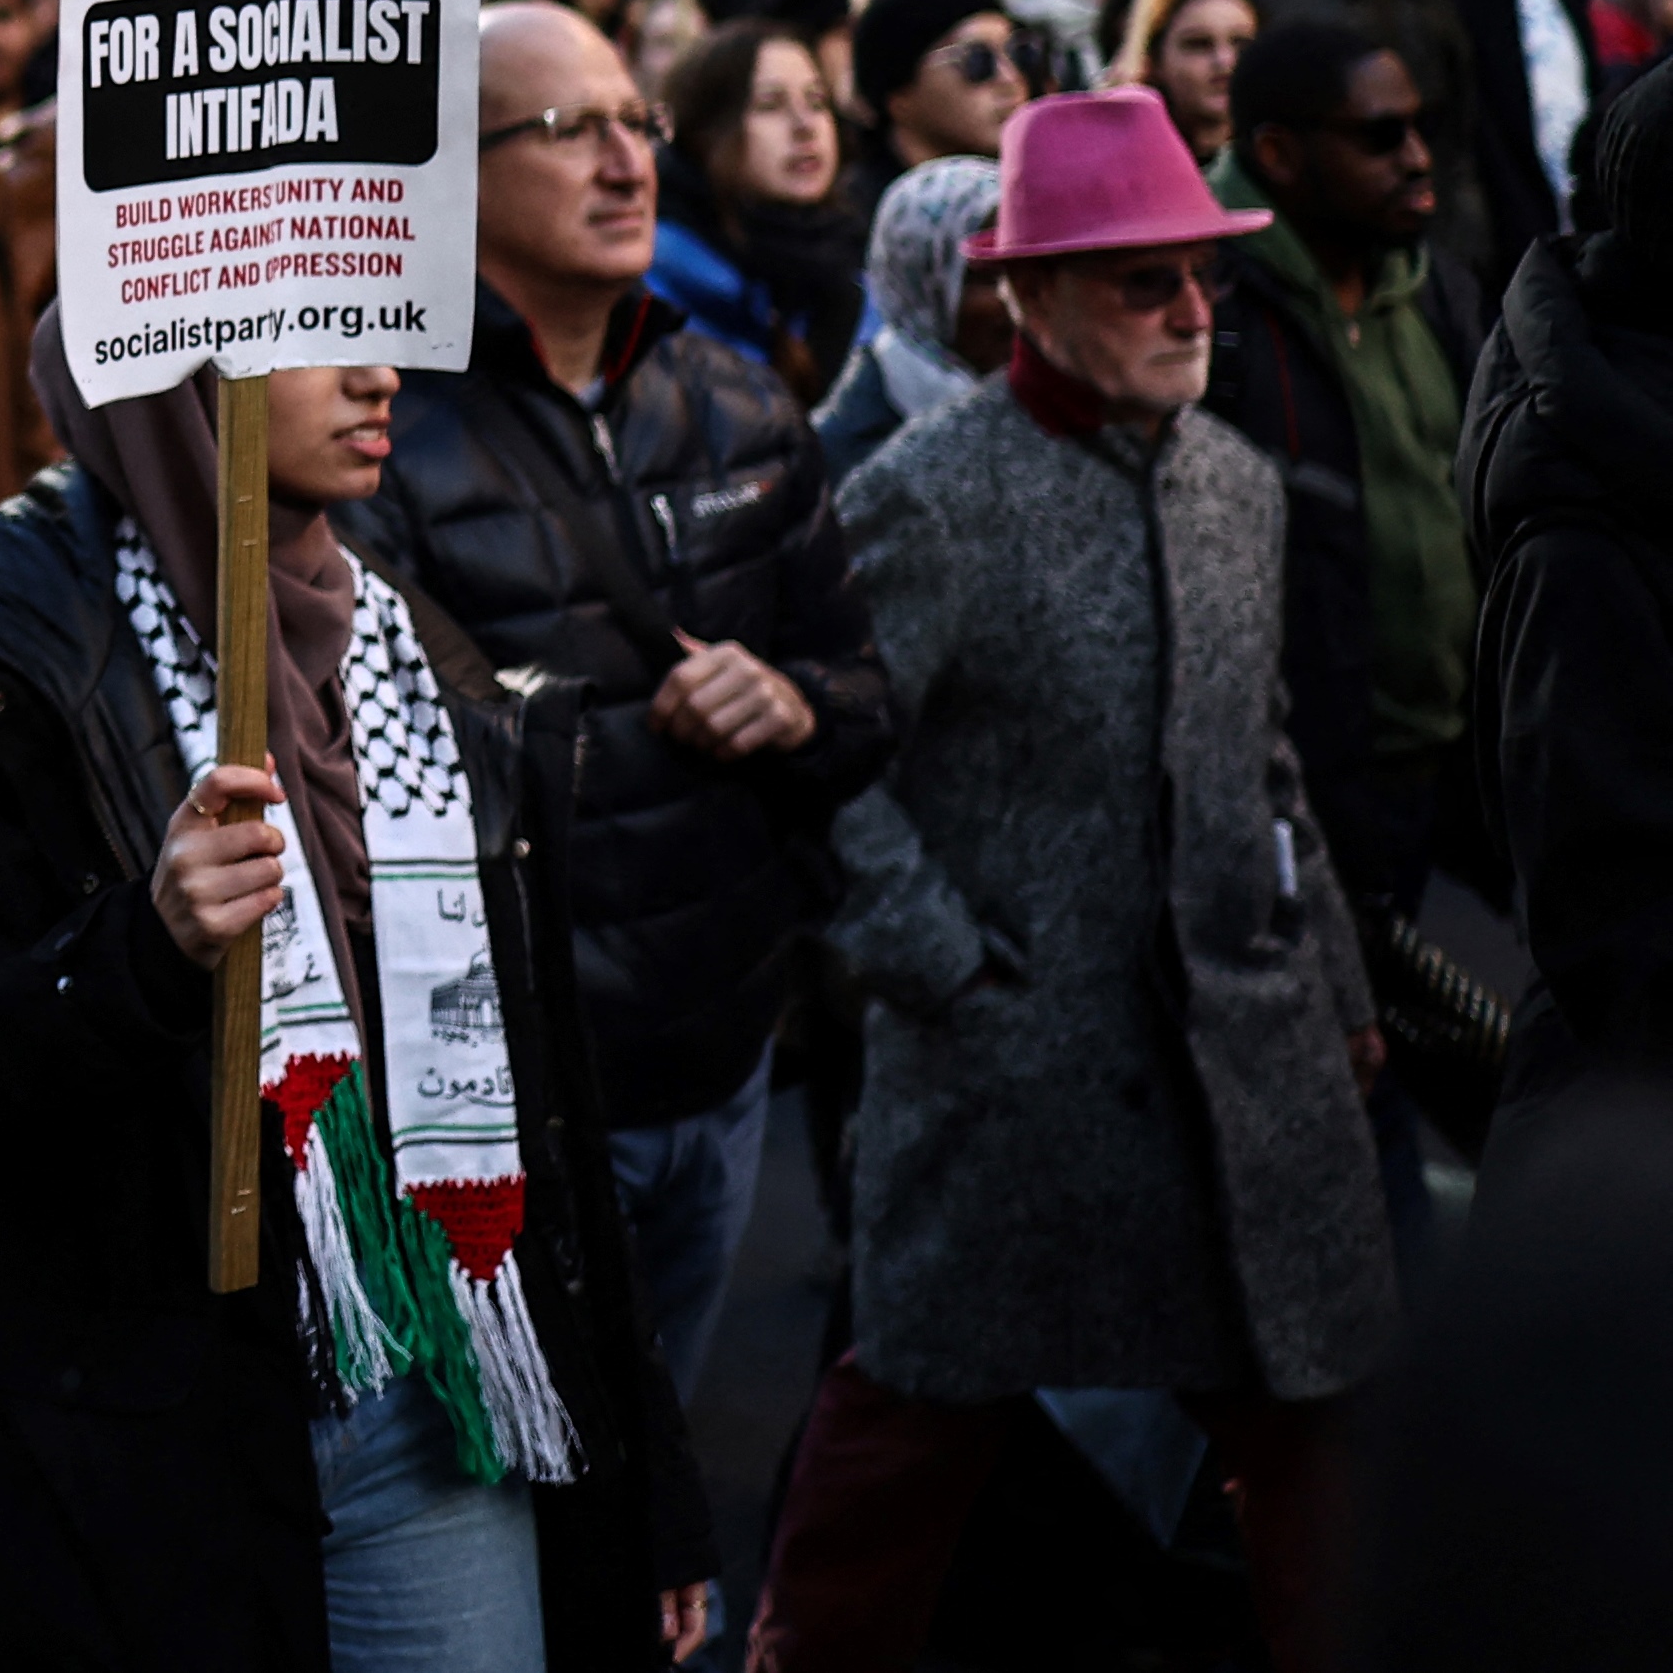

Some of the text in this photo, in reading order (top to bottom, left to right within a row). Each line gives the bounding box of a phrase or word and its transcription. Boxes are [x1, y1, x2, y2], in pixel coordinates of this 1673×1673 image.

[90, 14, 160, 88] FOR
[172, 10, 199, 78] A
[165, 77, 339, 161] INTIFADA
[115, 197, 172, 229] BUILD
[275, 179, 344, 205] UNITY
[350, 179, 404, 204] AND
[107, 216, 415, 269] STRUGGLE AGAINST NATIONAL
[121, 268, 210, 305] CONFLICT
[218, 261, 260, 290] AND
[94, 300, 428, 364] socialistparty.org.uk
